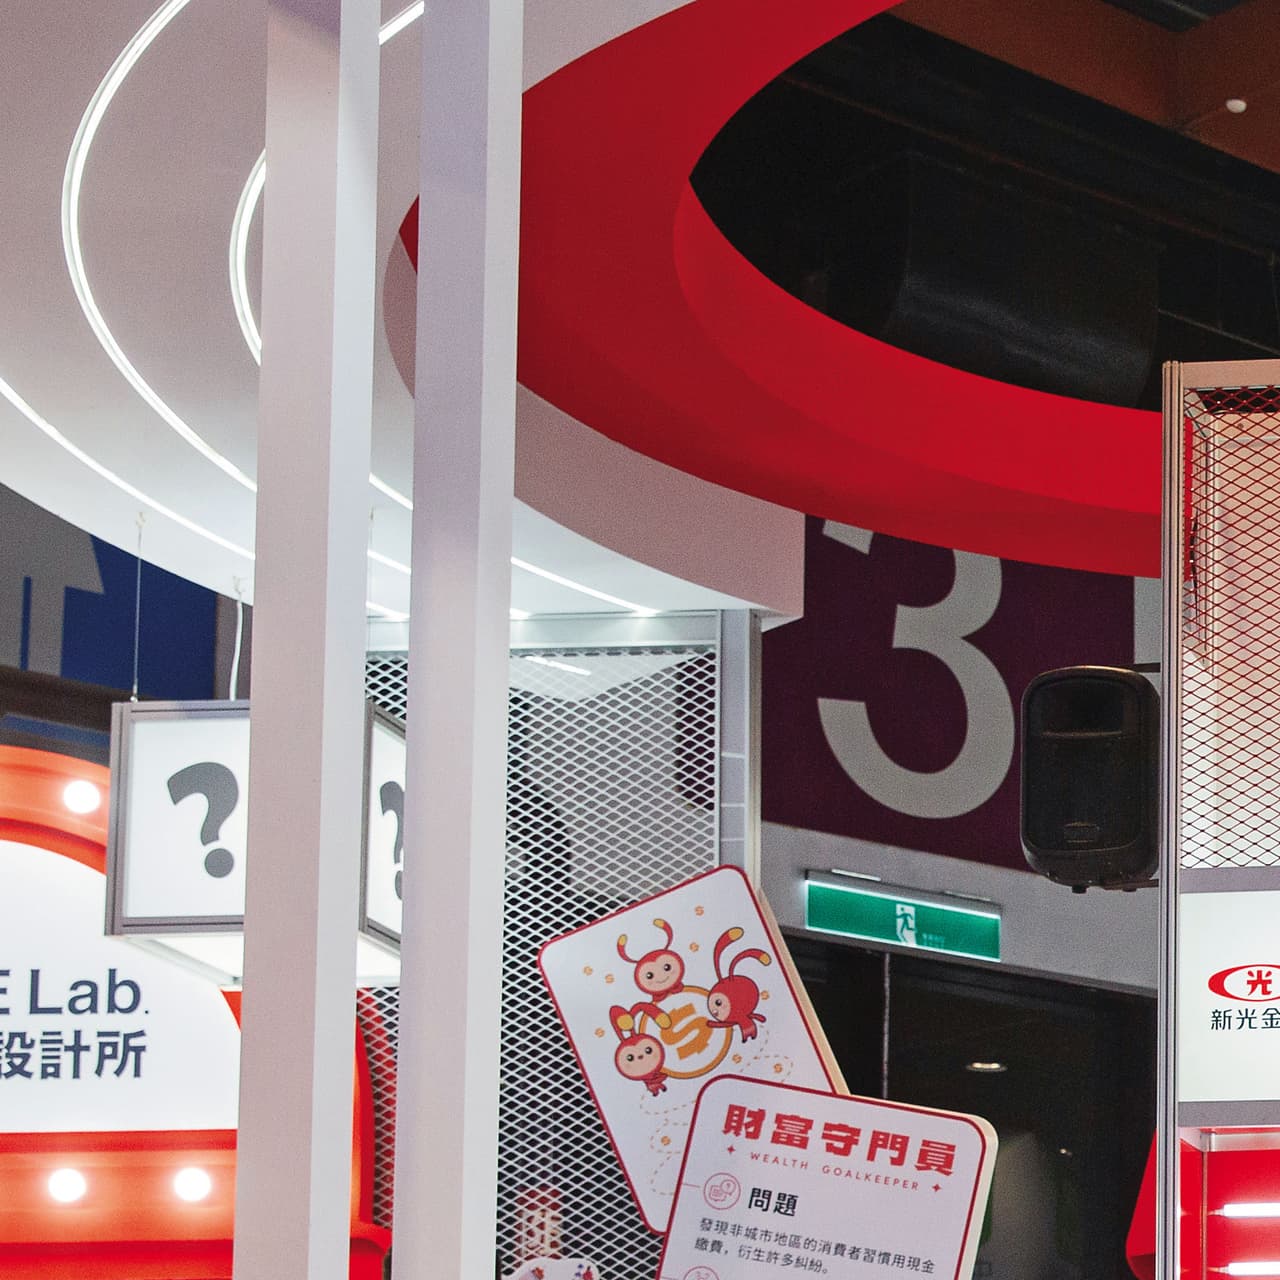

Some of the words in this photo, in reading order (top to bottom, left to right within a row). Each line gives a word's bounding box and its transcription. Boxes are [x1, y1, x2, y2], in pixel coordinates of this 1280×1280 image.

[817, 519, 1016, 819] 3
[722, 1103, 957, 1177] 財富守門員
[750, 1151, 809, 1171] WEALTH
[821, 1164, 920, 1191] GOALKEEPER
[747, 1187, 799, 1217] 問題
